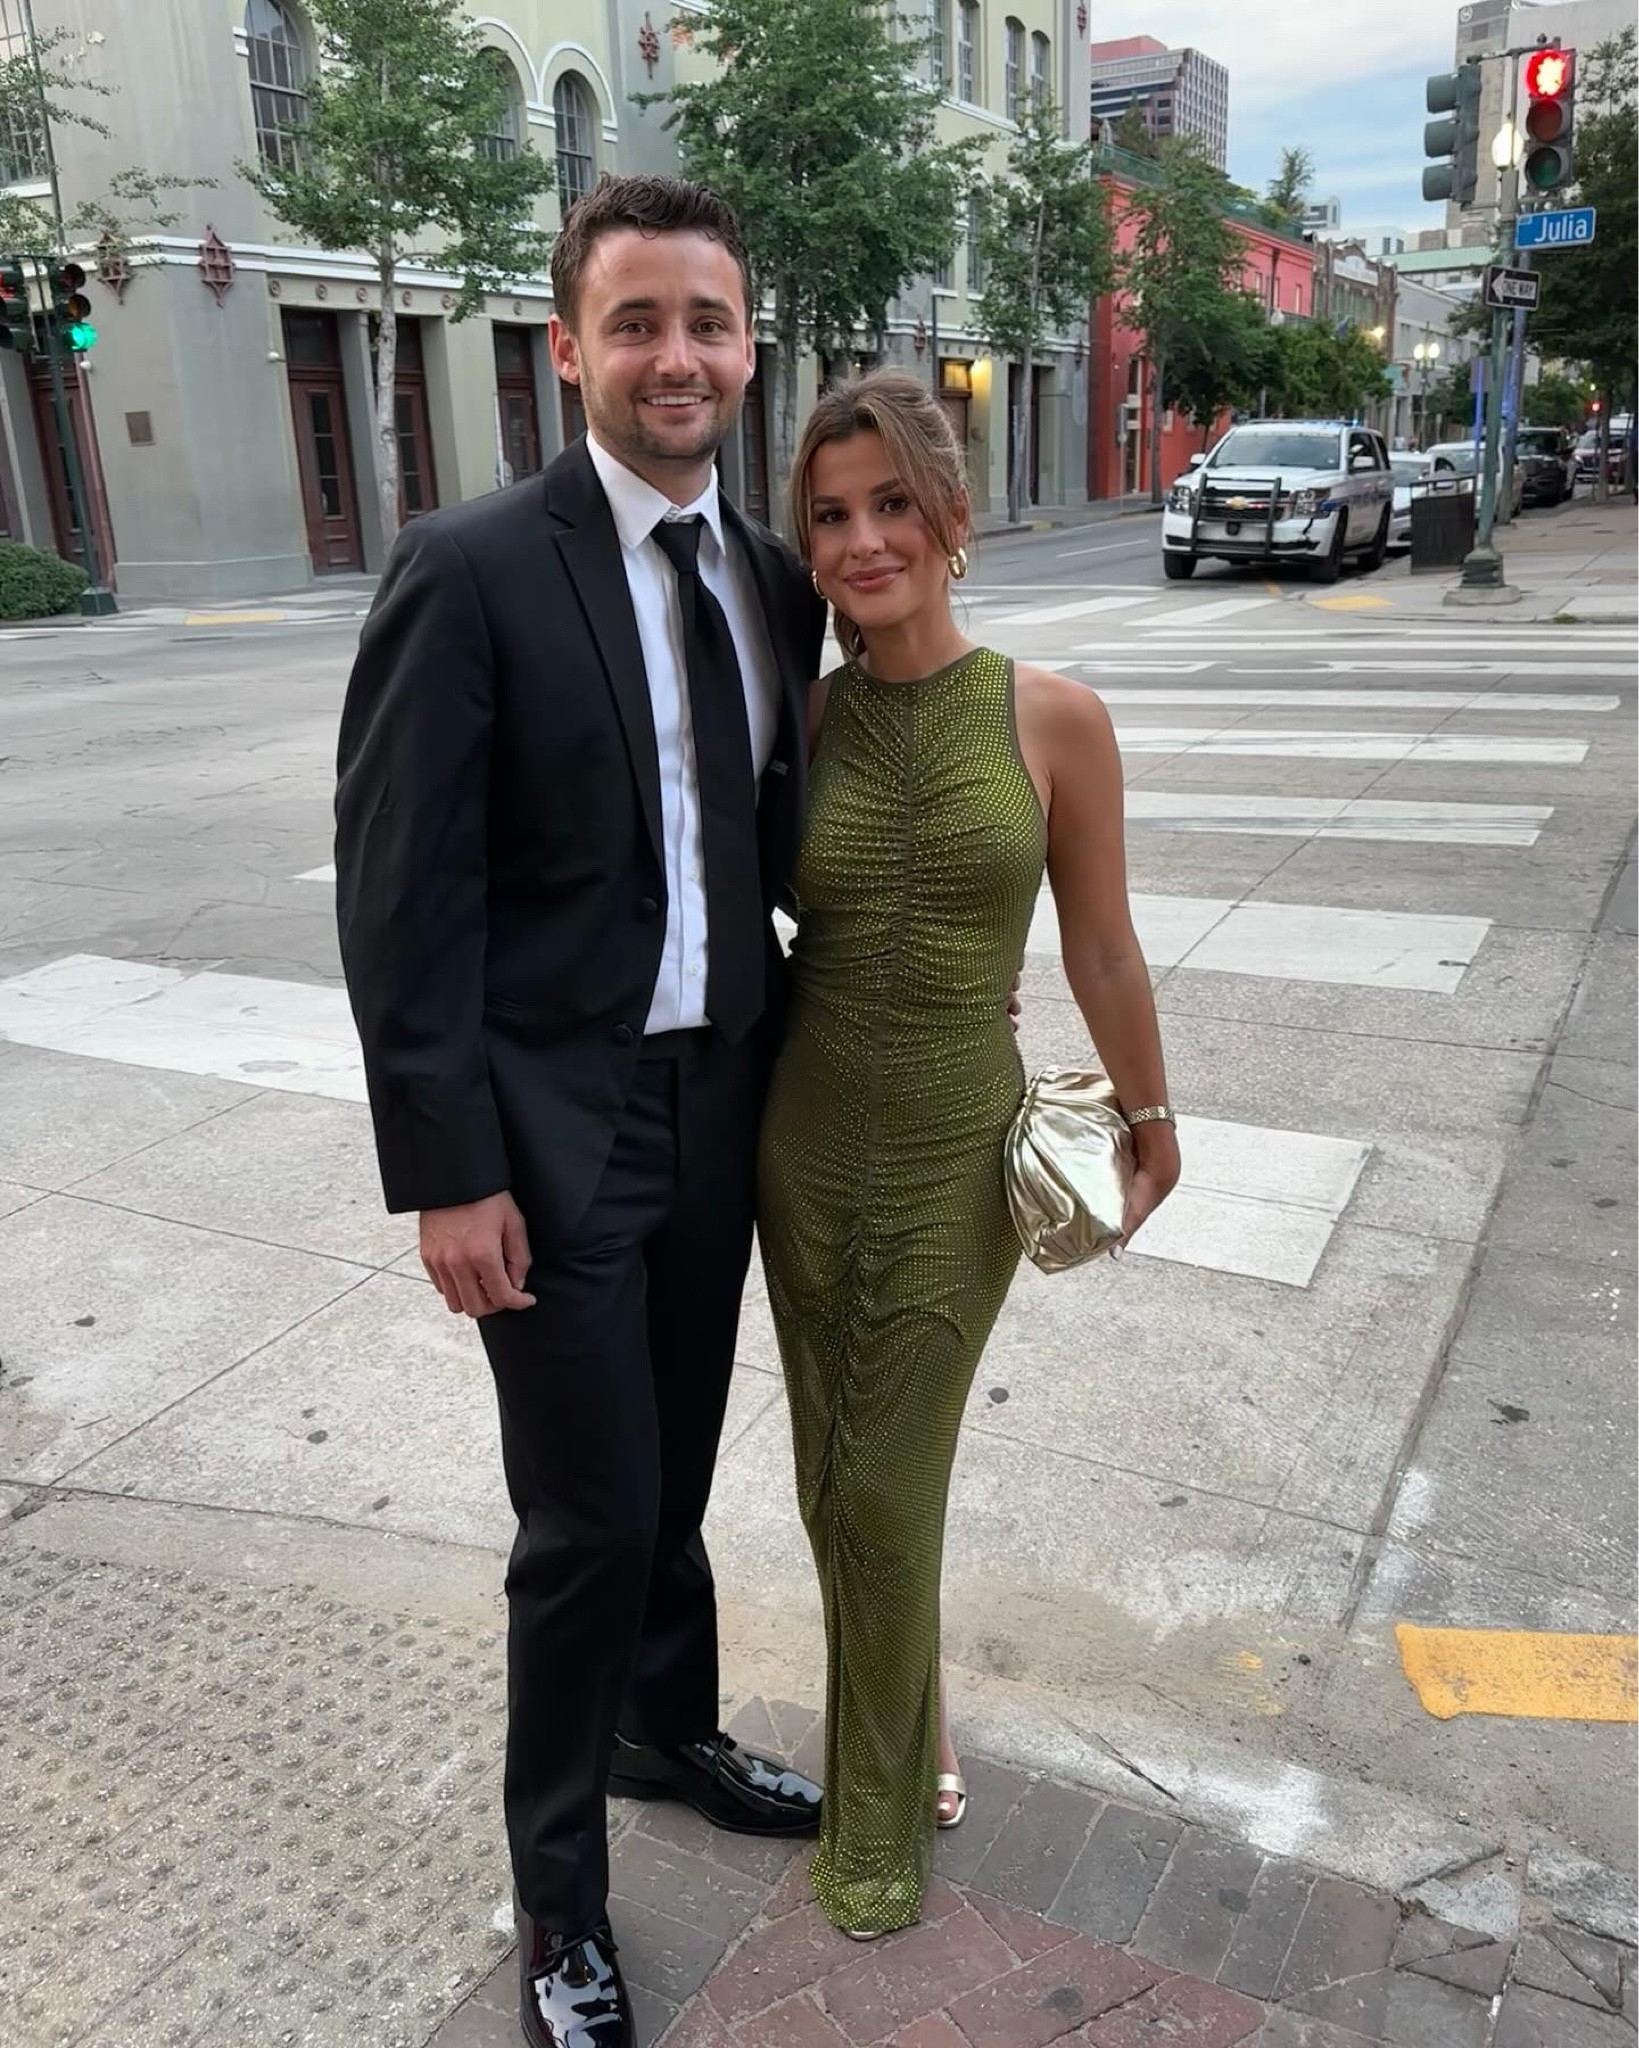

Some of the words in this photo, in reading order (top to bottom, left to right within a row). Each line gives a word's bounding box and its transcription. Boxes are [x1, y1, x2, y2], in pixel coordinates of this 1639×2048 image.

[1534, 214, 1587, 242] Julia
[1503, 280, 1517, 296] ONE
[1519, 281, 1534, 297] WAY
